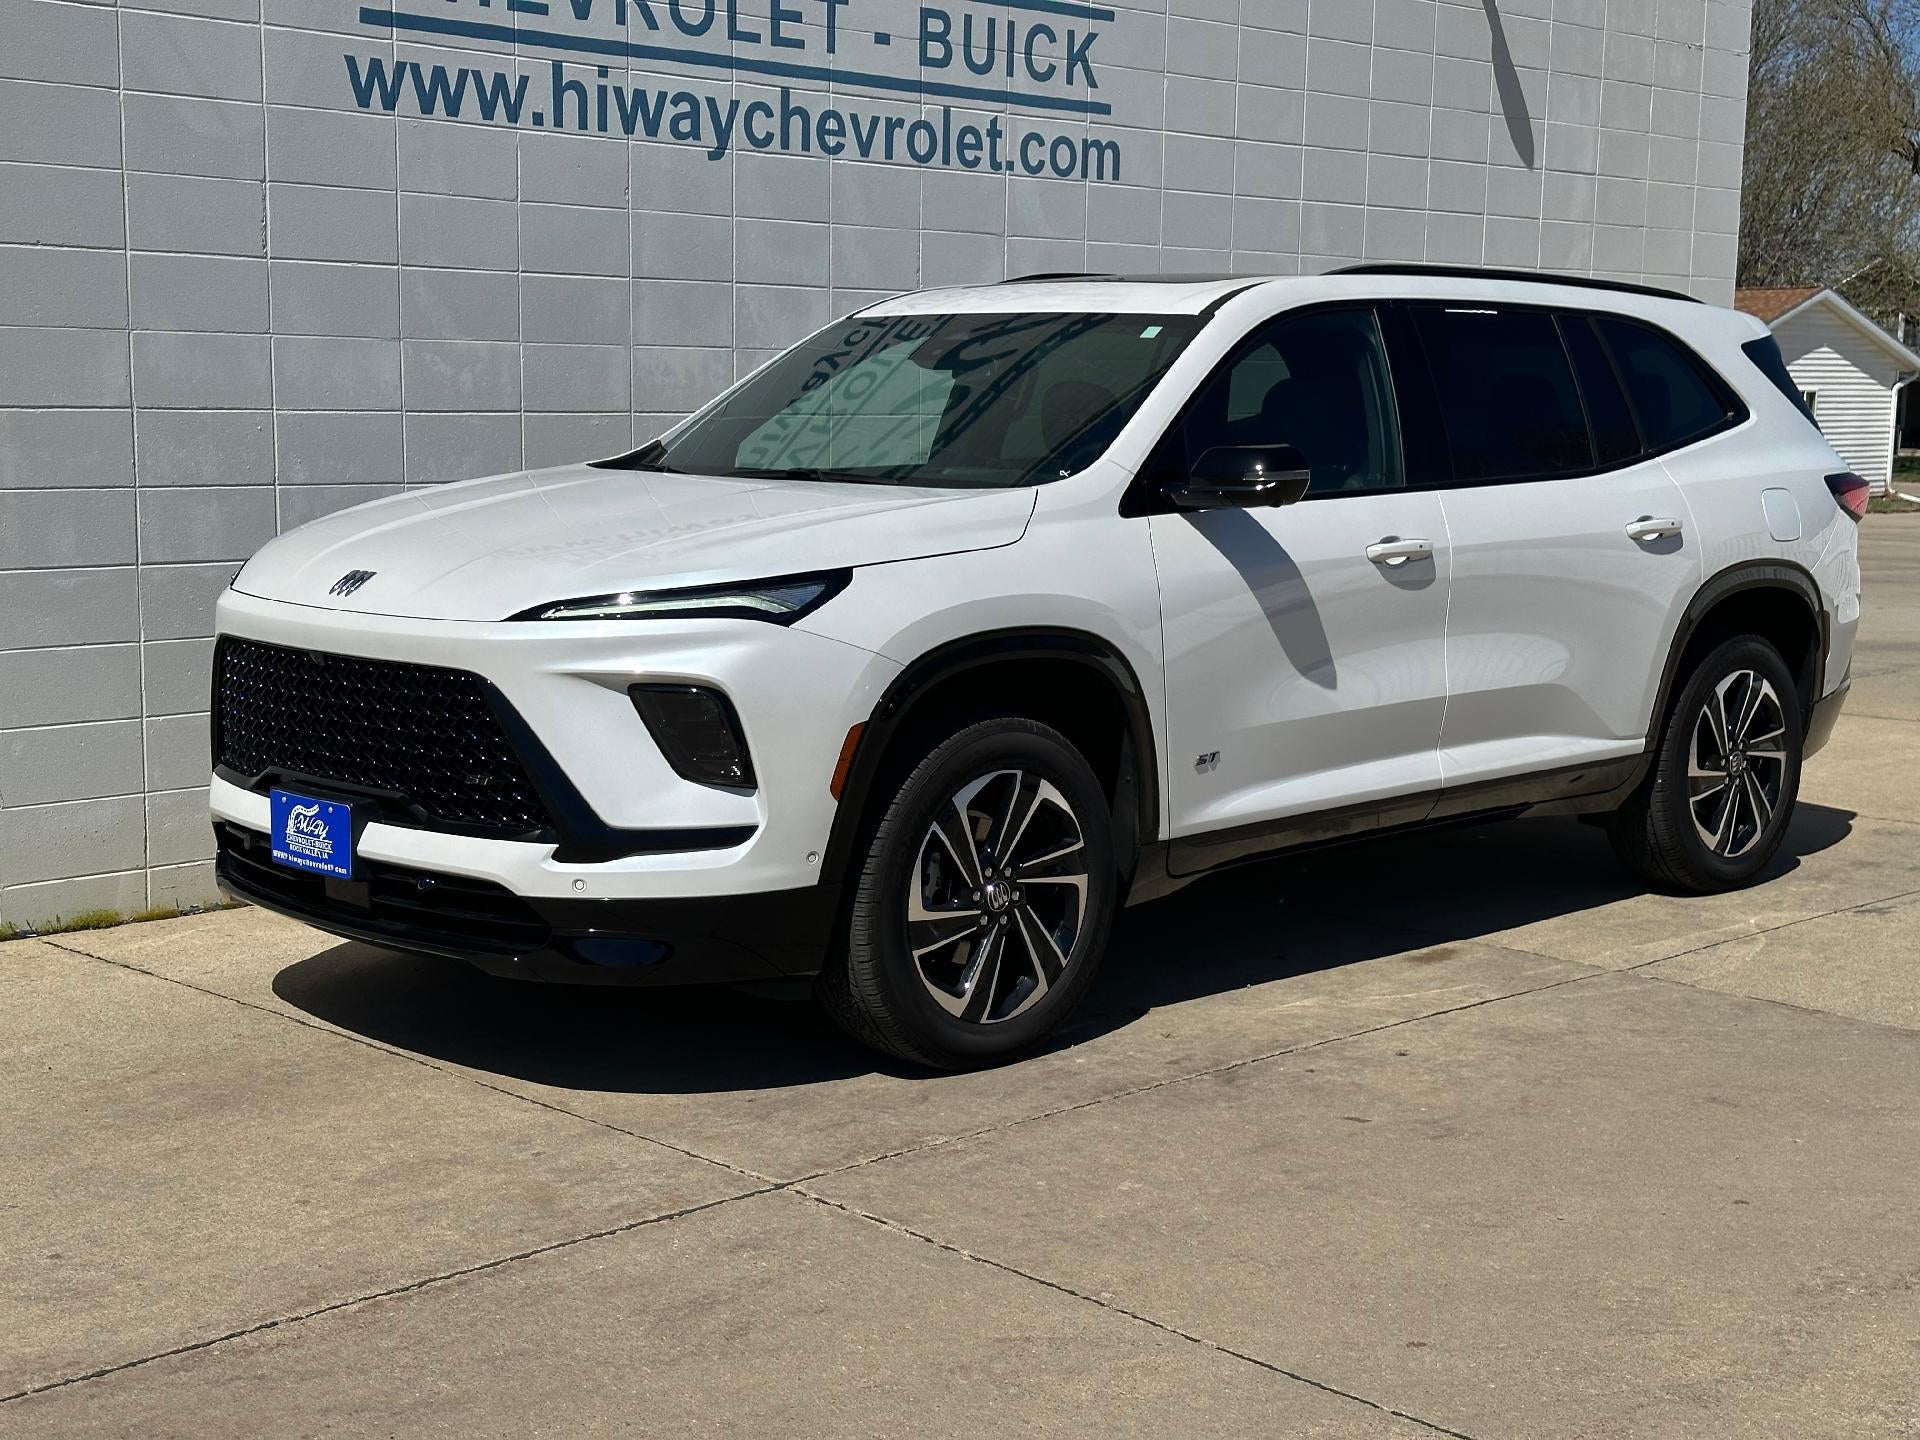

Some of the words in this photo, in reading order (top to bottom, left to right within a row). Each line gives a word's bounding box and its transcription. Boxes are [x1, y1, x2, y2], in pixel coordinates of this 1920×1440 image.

[919, 6, 1100, 89] BUICK
[343, 54, 1121, 181] www.hiwaychevrolet.com
[1195, 751, 1220, 767] ST
